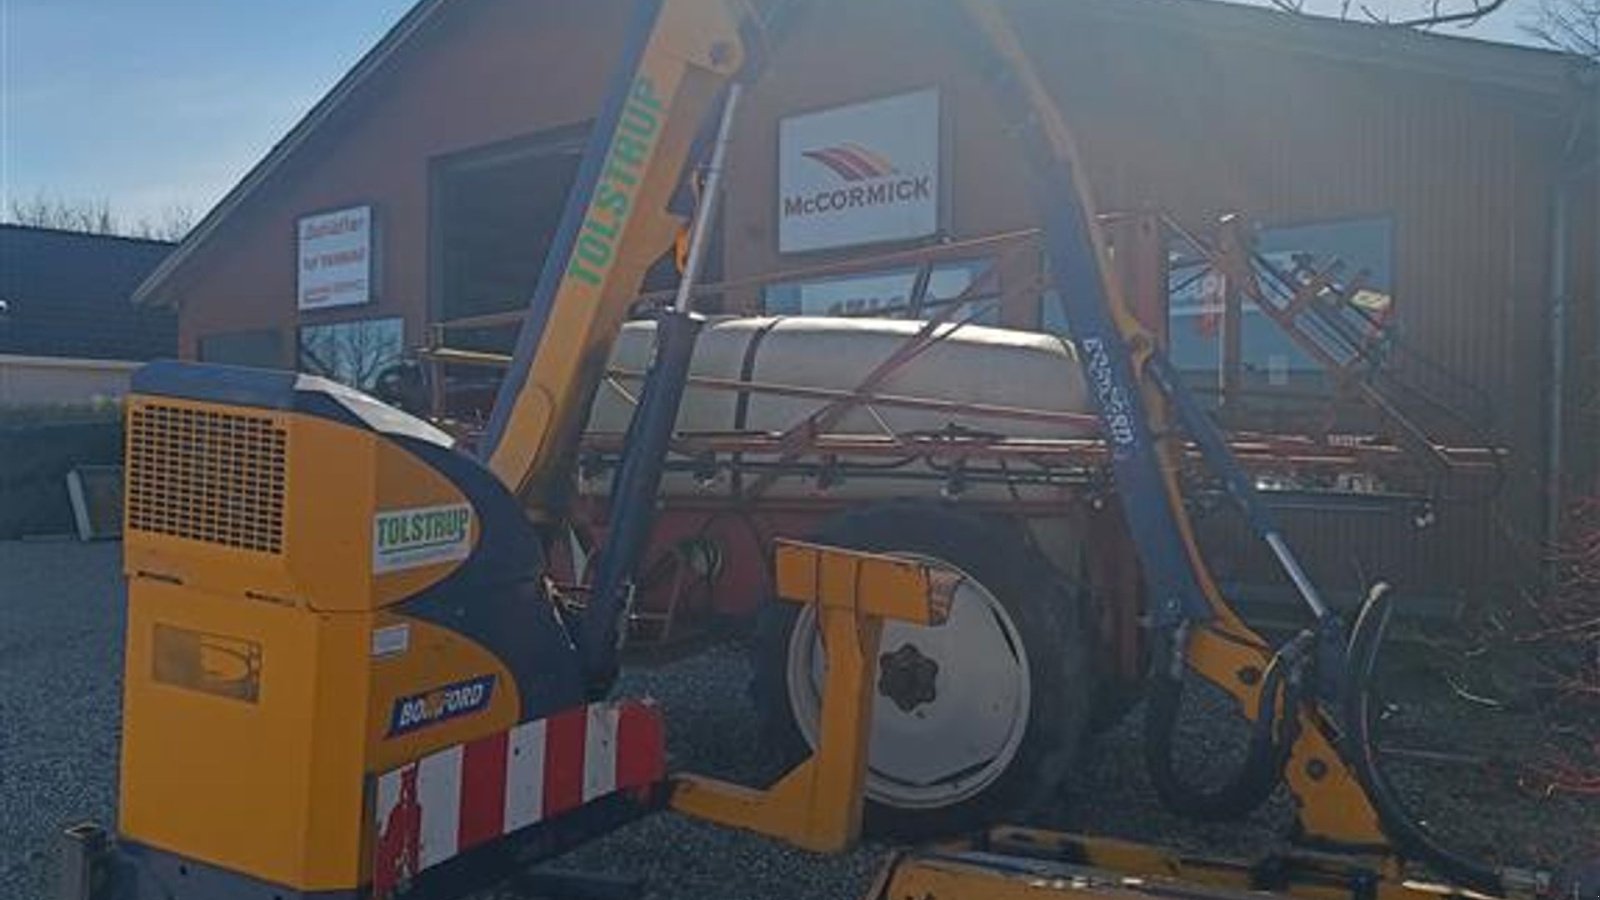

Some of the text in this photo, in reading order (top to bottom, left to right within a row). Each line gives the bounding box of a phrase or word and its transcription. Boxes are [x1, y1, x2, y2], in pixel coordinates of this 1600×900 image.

[568, 76, 662, 285] TOLSTRUP
[784, 174, 932, 218] McCORMICK
[377, 508, 470, 547] TOLSTRUP
